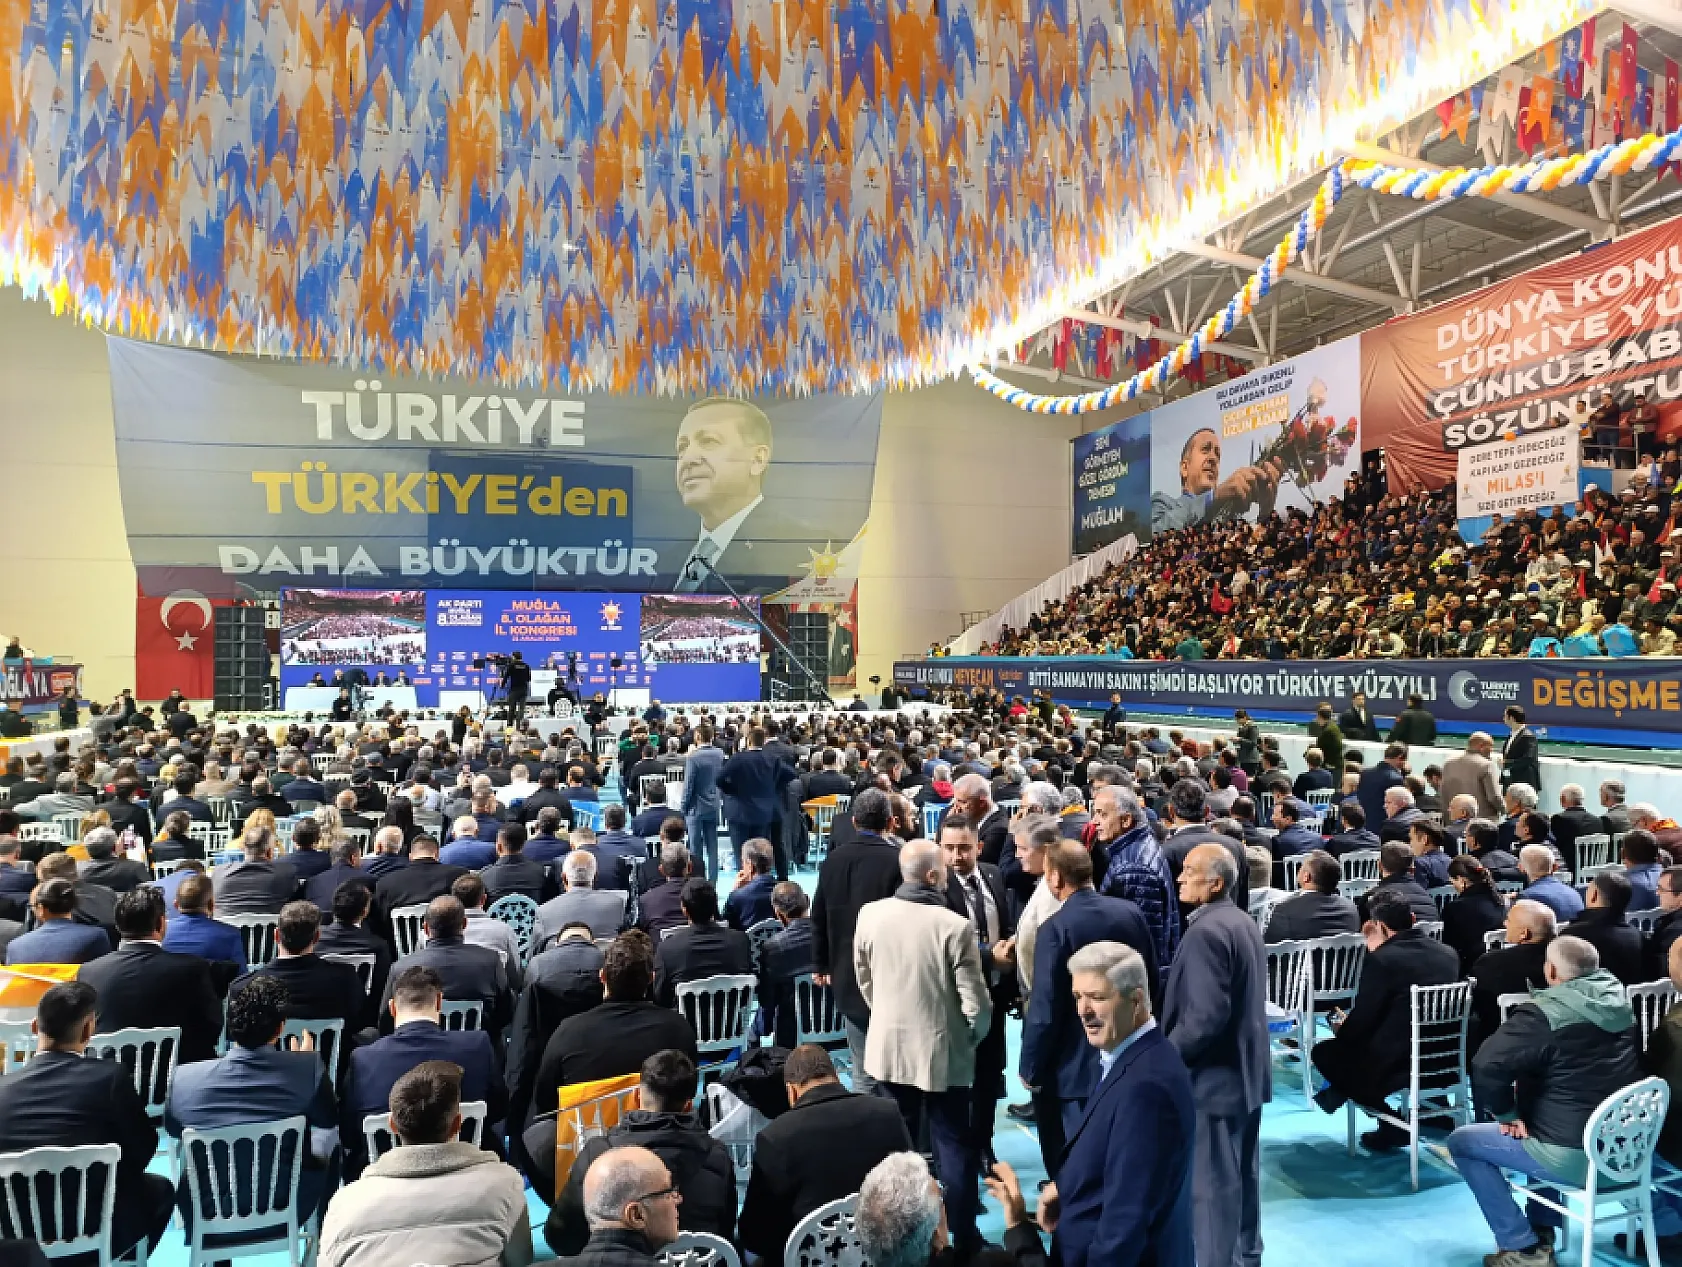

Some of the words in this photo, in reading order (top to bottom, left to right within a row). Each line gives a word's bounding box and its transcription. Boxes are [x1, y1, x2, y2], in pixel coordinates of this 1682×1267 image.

[1437, 289, 1562, 351] DÜNYA
[1437, 312, 1608, 380] TÜRKİYE
[1434, 353, 1570, 420] ÇÜNKÜ
[1583, 330, 1681, 376] BAB
[301, 380, 586, 446] TÜRKİYE
[217, 544, 384, 576] DAHA
[399, 538, 658, 577] BÜYÜKTÜR
[1188, 673, 1264, 699] BAŞLIYOR
[1266, 668, 1345, 698] TÜRKİYE
[1532, 671, 1681, 718] DEĞİŞME
